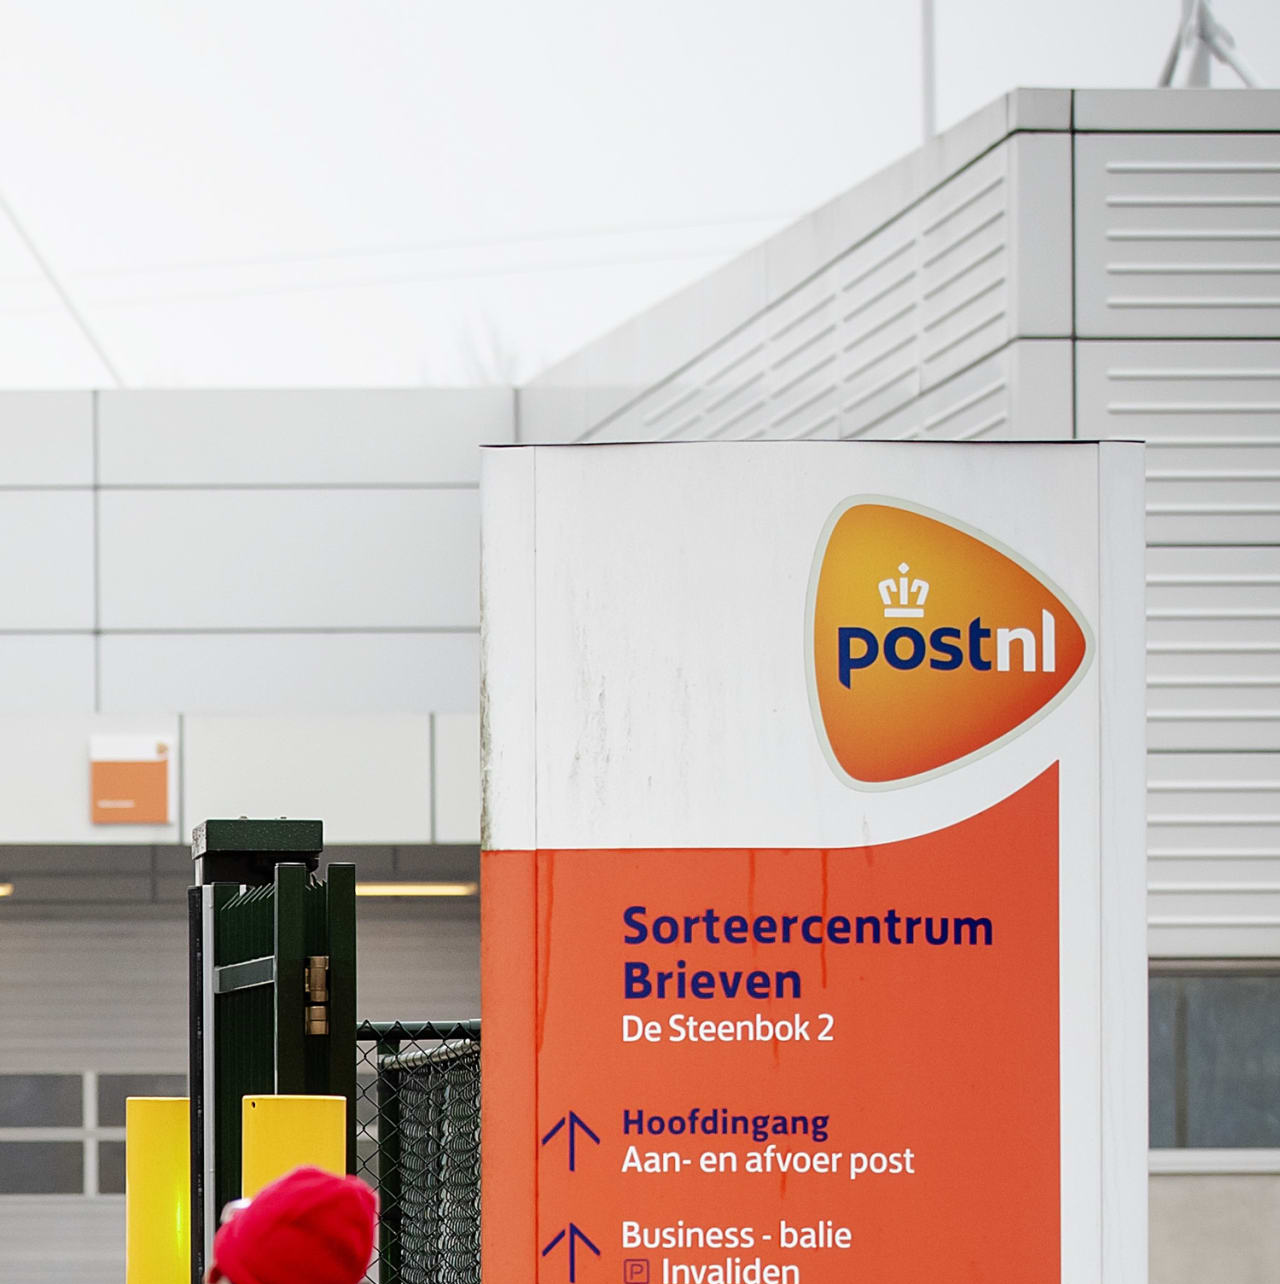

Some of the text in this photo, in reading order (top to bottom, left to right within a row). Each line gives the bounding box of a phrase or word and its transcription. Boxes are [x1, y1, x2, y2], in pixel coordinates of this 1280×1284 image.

[838, 608, 1056, 690] postnl
[623, 906, 994, 946] Sorteercentrum
[624, 959, 802, 1000] Brieven
[622, 1013, 835, 1043] De Steenbok 2
[623, 1107, 830, 1142] Hoofdingang
[621, 1144, 916, 1181] Aan- en afvoer post
[622, 1220, 755, 1250] Business
[780, 1220, 853, 1250] balie
